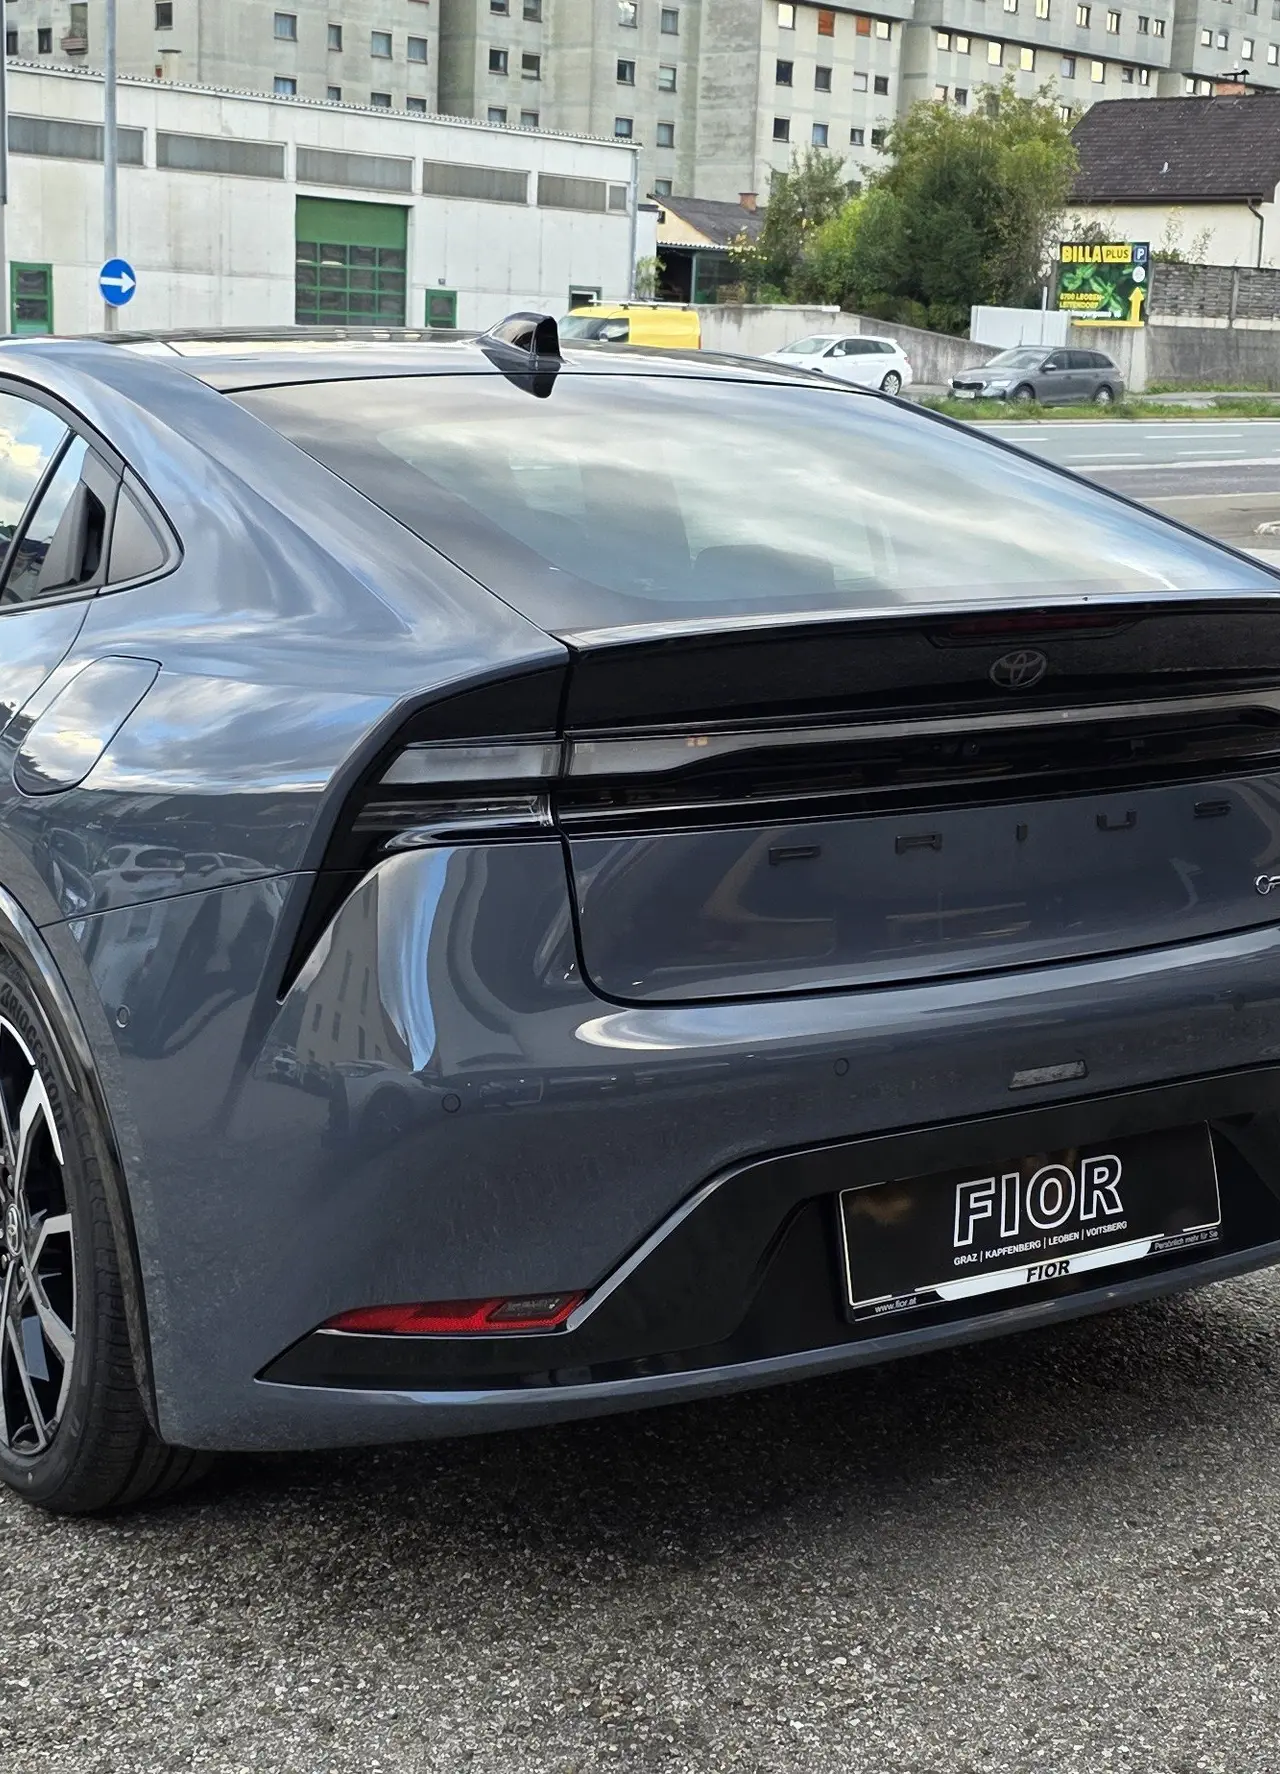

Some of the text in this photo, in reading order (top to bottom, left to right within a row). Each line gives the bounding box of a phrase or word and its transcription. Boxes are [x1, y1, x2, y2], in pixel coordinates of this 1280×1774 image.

[1062, 245, 1145, 263] BILLA PLUS P
[768, 801, 1232, 865] PRIUS
[953, 1154, 1124, 1247] FIOR
[953, 1220, 1128, 1266] GRAZ KAPFENBERG LEOBEN VOITSBERG
[1026, 1260, 1070, 1282] FIOR
[874, 1297, 917, 1313] www.fior.at
